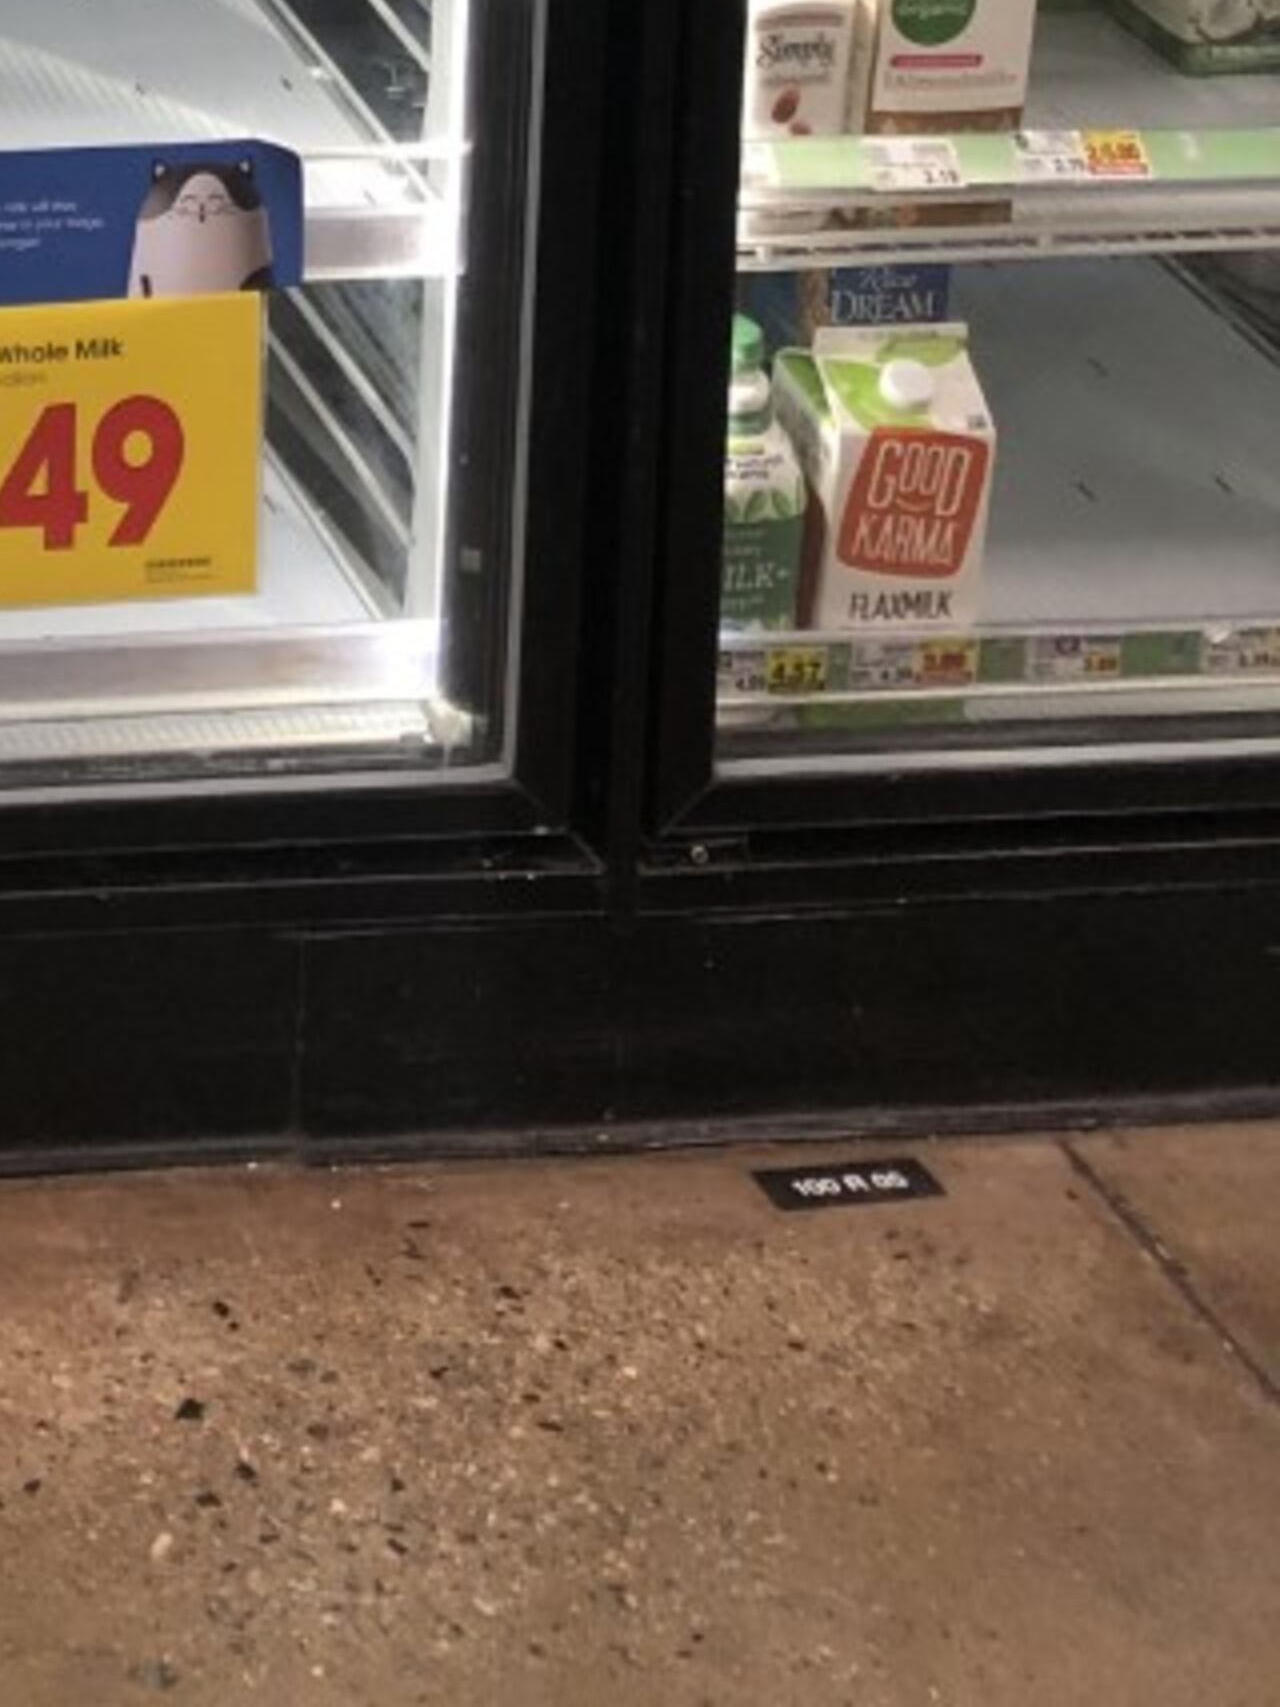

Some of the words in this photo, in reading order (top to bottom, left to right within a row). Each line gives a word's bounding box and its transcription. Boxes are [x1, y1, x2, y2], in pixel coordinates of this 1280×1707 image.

[830, 291, 935, 325] DREAM
[75, 338, 124, 362] Milk
[867, 438, 971, 516] GOOD
[851, 514, 956, 568] KARMA
[848, 590, 953, 621] FLAXMILK
